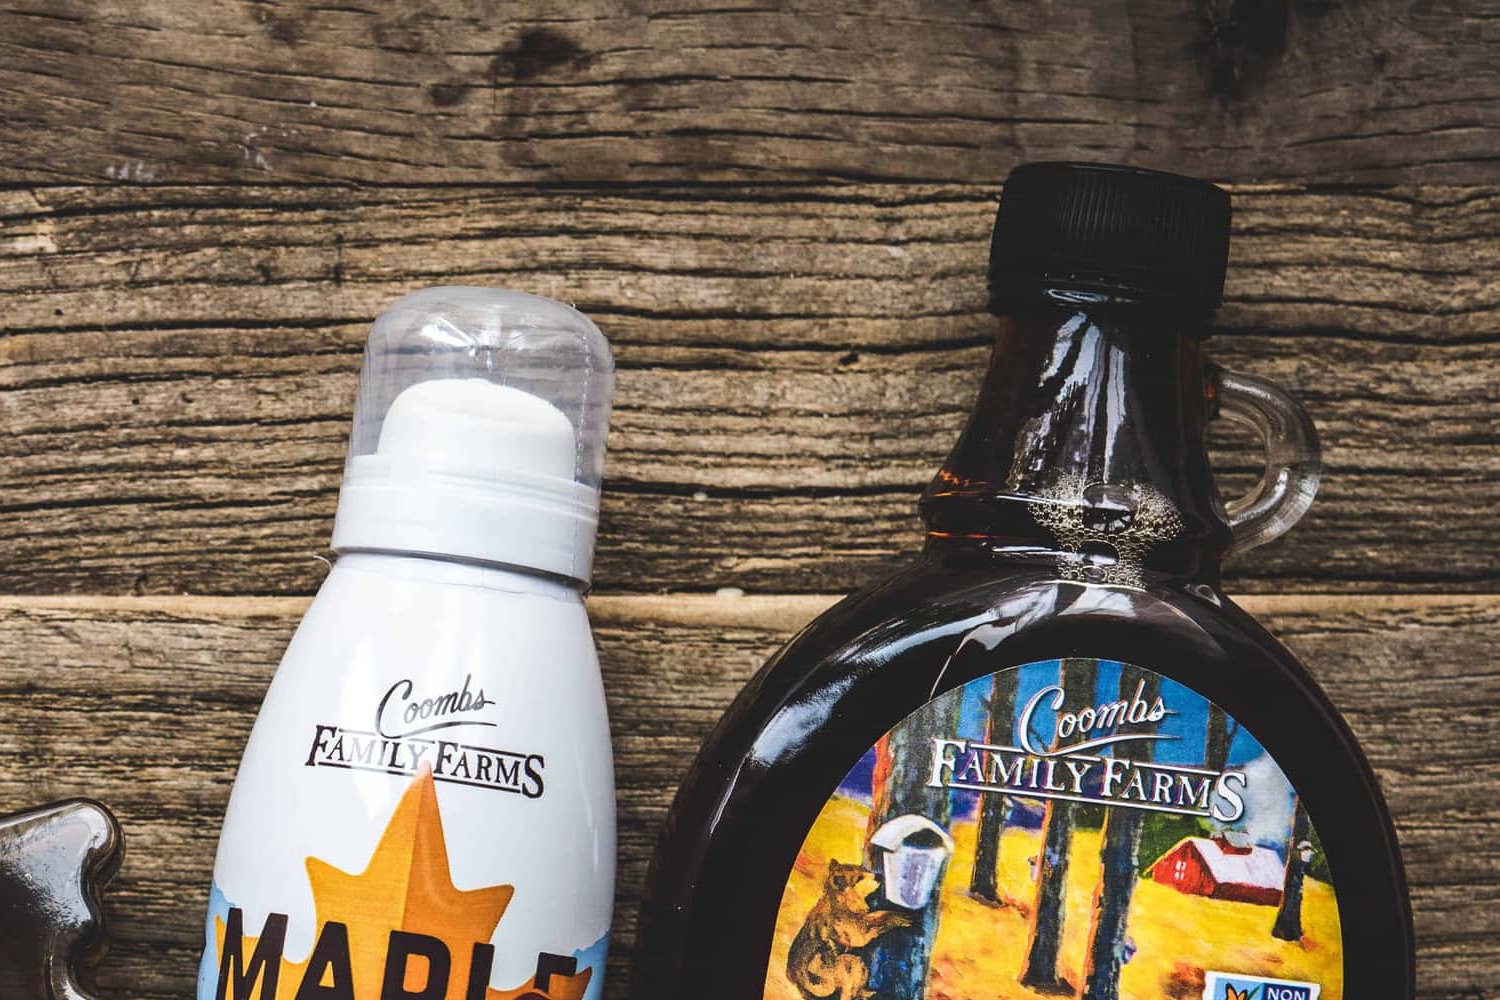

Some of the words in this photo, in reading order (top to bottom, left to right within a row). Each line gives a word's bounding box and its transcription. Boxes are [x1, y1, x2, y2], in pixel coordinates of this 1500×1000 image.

[376, 674, 498, 741] Coombs
[1019, 679, 1179, 757] Coombs
[305, 726, 428, 772] FAMILY
[434, 741, 546, 799] FARMS
[928, 739, 1092, 793] FAMILY
[1101, 759, 1247, 822] FARMS
